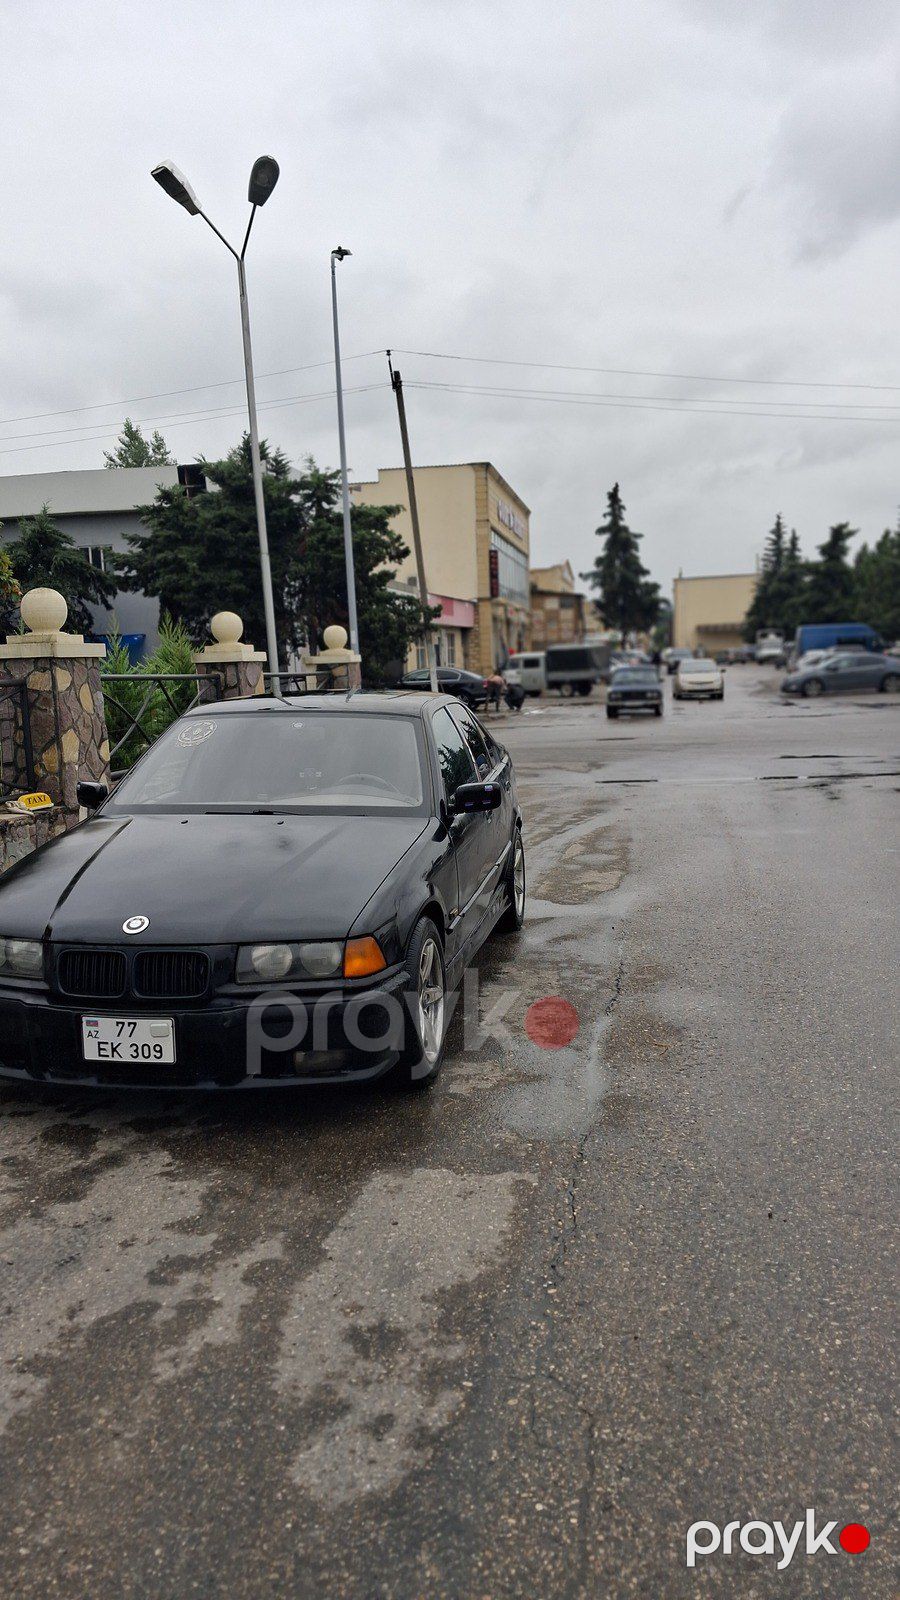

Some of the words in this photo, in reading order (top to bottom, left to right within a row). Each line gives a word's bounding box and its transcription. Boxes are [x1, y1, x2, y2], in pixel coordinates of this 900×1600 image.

[27, 795, 47, 804] TAXI
[86, 1030, 100, 1039] AZ
[115, 1021, 138, 1038] 77
[97, 1041, 123, 1058] EK
[129, 1043, 163, 1059] 309
